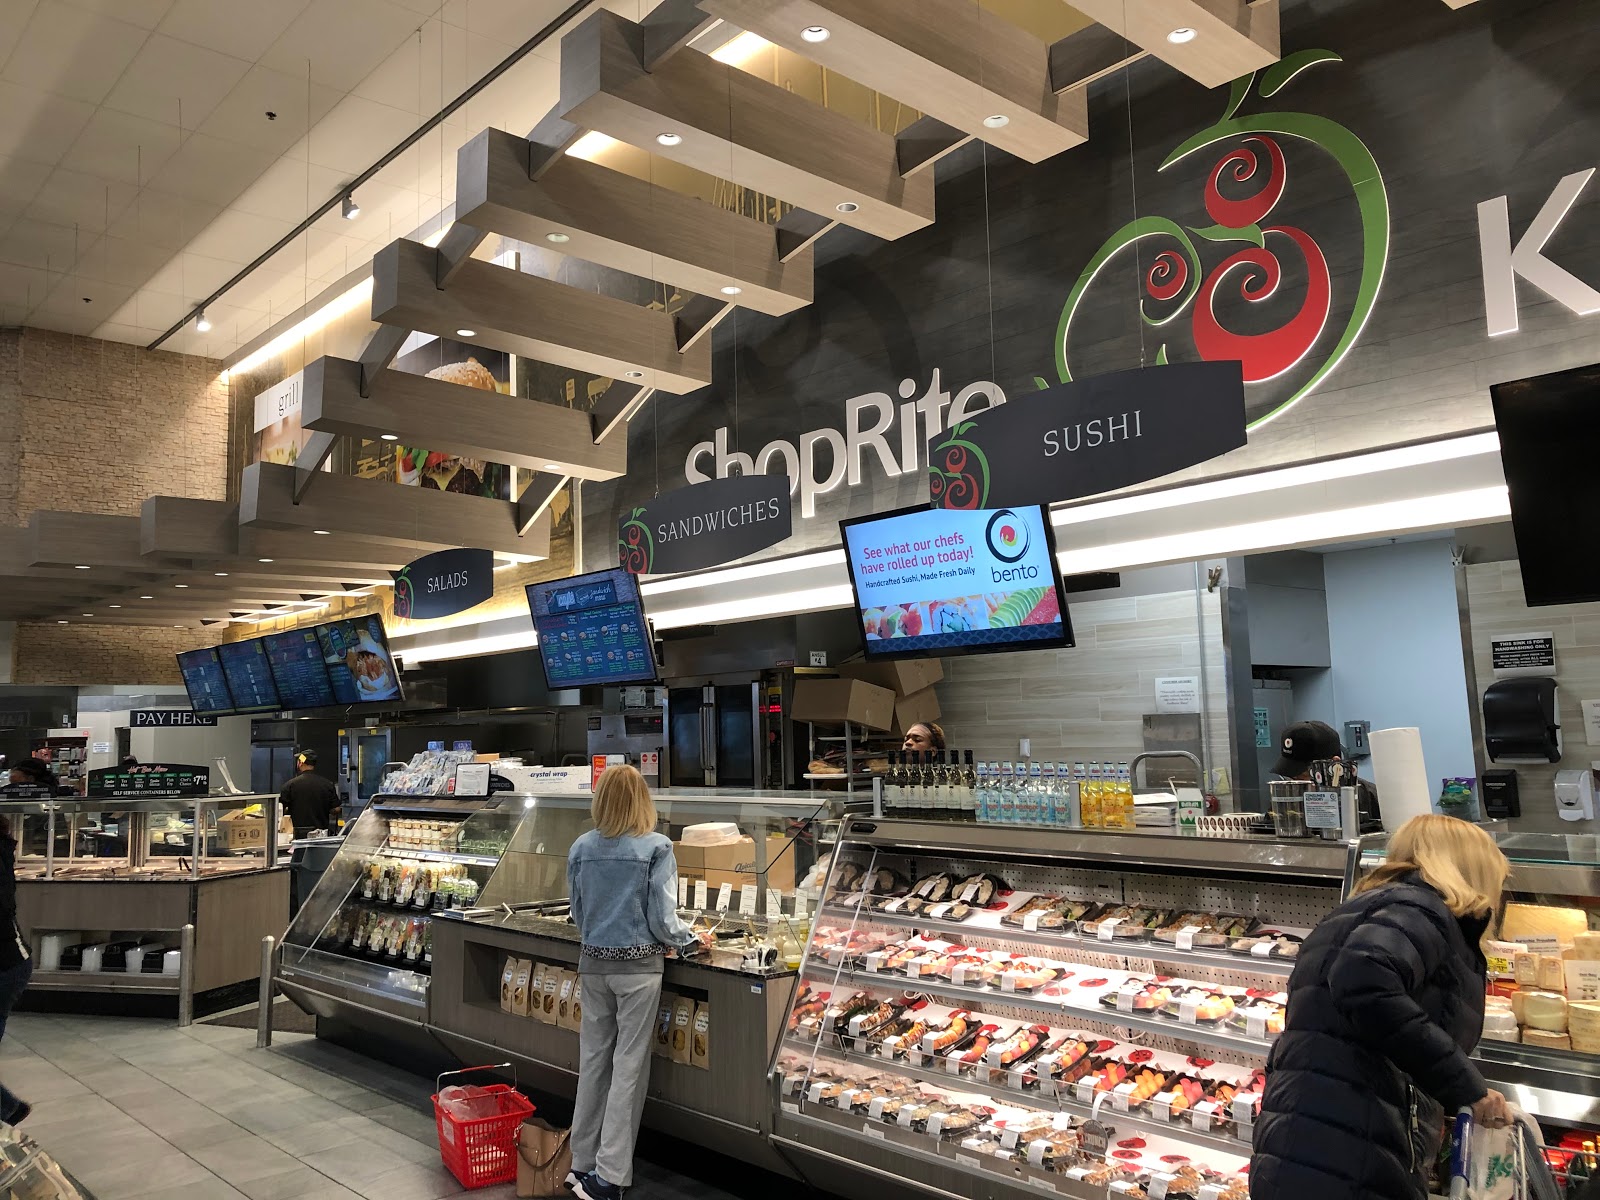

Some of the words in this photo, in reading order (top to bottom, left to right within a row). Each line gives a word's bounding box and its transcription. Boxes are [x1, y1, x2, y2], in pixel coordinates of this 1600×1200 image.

[1477, 167, 1600, 337] K
[278, 380, 299, 417] grill
[1043, 409, 1143, 457] SUSHI
[657, 497, 780, 544] SANDWICHES
[860, 563, 885, 575] have
[887, 555, 919, 571] rolled
[920, 555, 935, 568] up
[937, 545, 974, 563] today!
[863, 547, 883, 560] See
[884, 542, 911, 556] what
[913, 539, 932, 552] our
[934, 532, 965, 548] chefs
[426, 570, 469, 593] SALADS
[865, 576, 901, 588] Handcrafted
[901, 573, 920, 584] Sushi,
[920, 571, 938, 581] Made
[939, 569, 957, 578] Fresh
[958, 566, 976, 576] Daily
[991, 564, 1038, 583] bento
[136, 712, 166, 725] PAY
